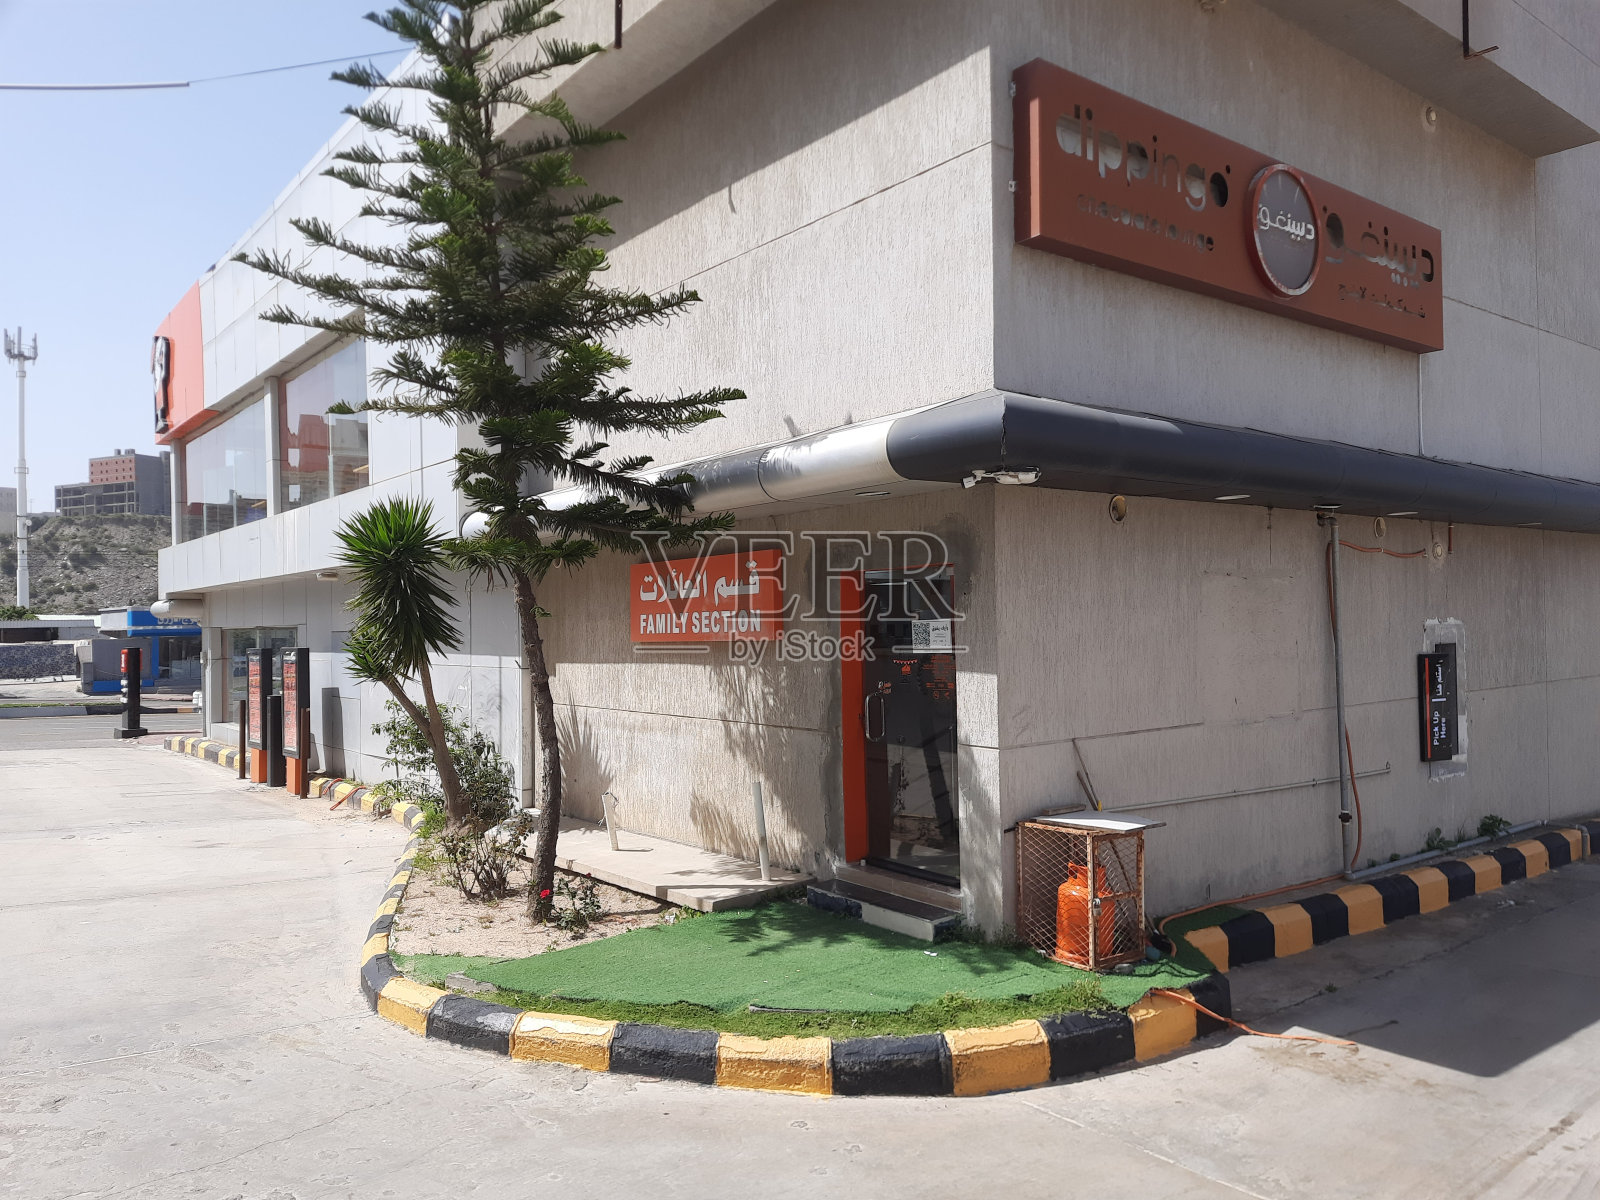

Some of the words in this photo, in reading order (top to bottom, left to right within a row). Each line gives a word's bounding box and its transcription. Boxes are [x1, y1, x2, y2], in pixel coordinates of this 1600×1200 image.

[1056, 104, 1231, 212] dippingo
[639, 568, 708, 603] العائلات
[713, 560, 760, 607] قسم
[640, 612, 689, 634] FAMILY
[691, 609, 761, 633] SECTION
[1433, 711, 1441, 724] Up
